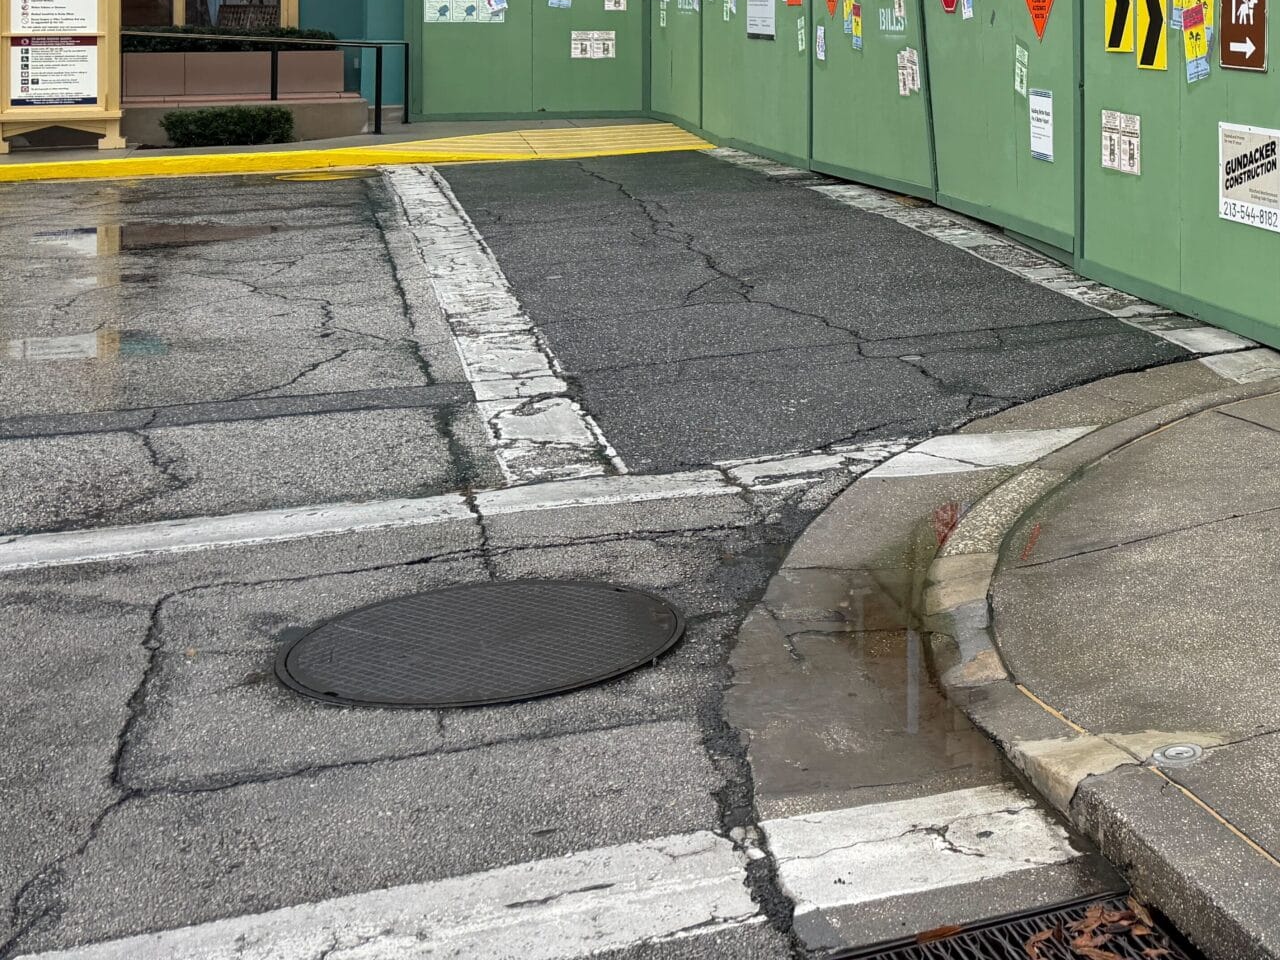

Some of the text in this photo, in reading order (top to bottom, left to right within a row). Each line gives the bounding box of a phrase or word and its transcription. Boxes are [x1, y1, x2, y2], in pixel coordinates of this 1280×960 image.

[1225, 141, 1276, 176] GUNDACKER
[1225, 157, 1277, 190] CONSTRUCTION
[1223, 201, 1278, 228] 213-544-8182
